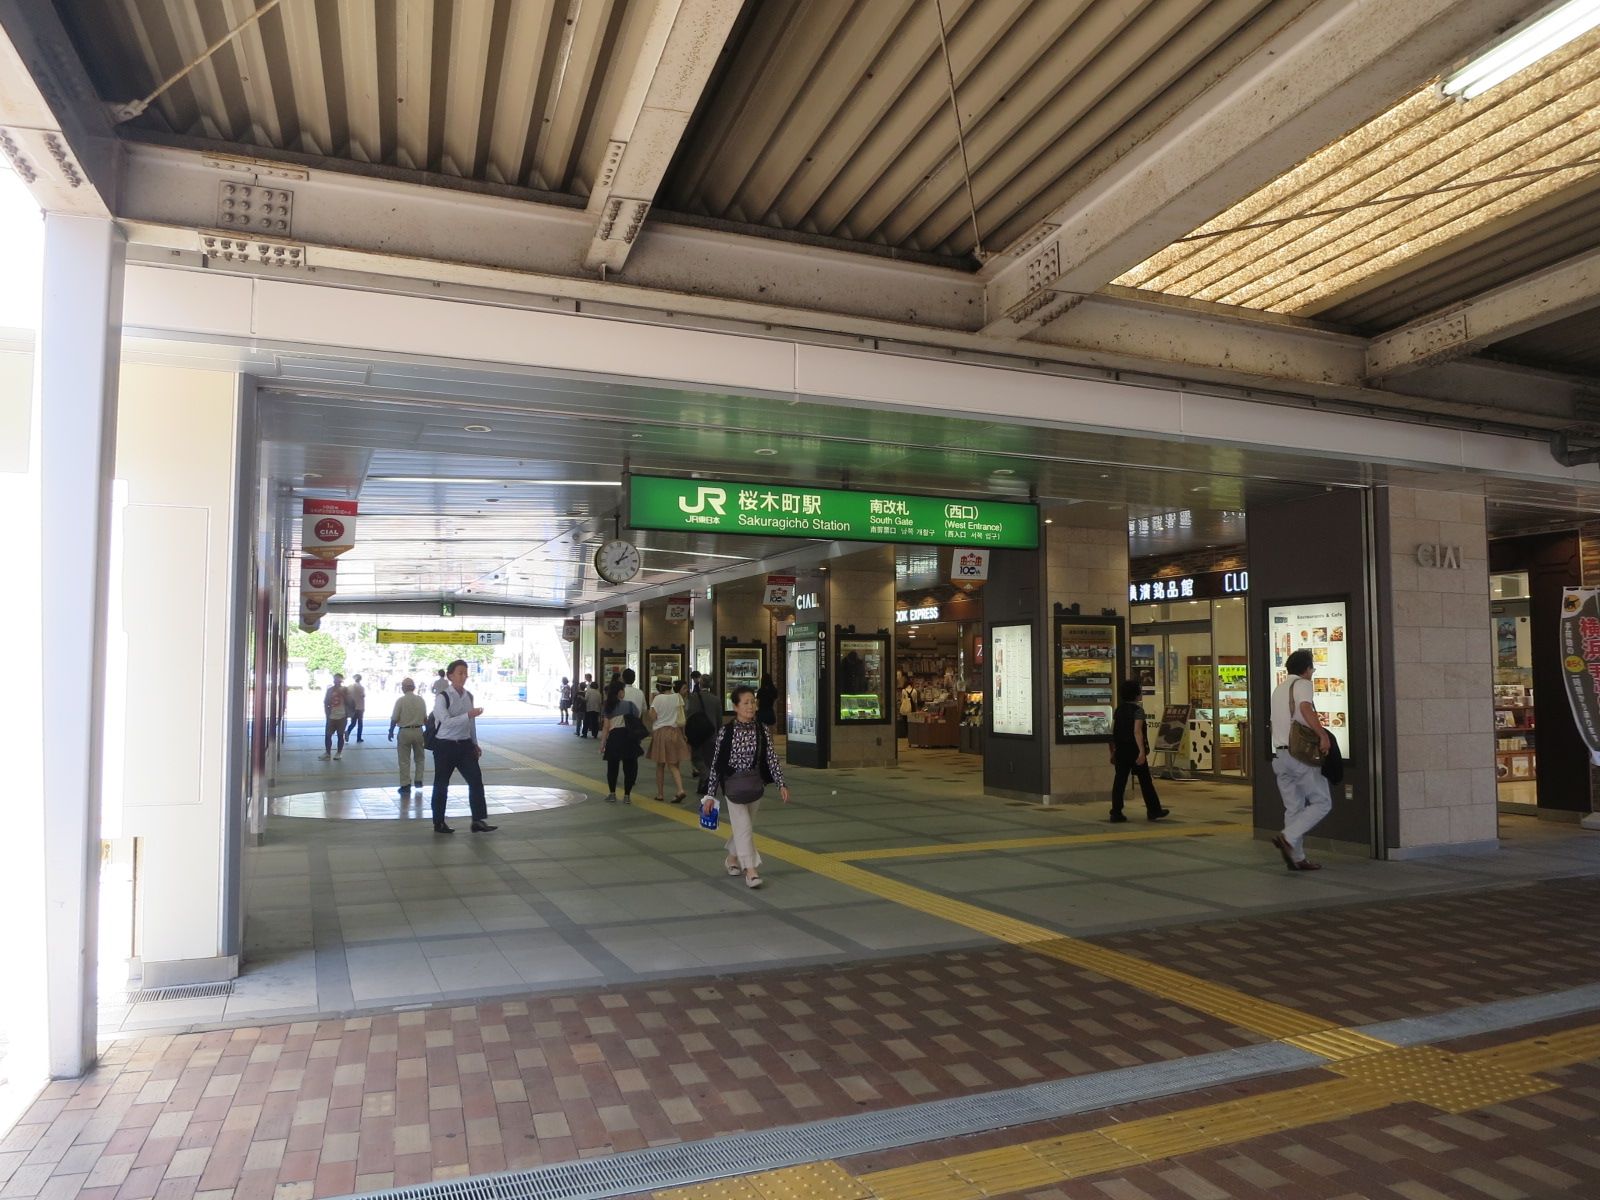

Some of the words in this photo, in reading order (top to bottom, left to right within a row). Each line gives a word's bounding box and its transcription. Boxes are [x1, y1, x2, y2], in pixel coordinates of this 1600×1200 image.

[679, 487, 727, 515] JR
[738, 490, 821, 515] 桜木町駅
[870, 499, 909, 515] 南改札
[685, 515, 720, 524] JR東日本
[944, 504, 979, 520] (西口)
[738, 514, 808, 530] Sakuragichō
[812, 518, 850, 531] Station
[870, 515, 892, 525] South
[895, 516, 913, 526] Gate
[945, 520, 966, 530] (West
[968, 522, 1003, 532] Entrance)
[1417, 543, 1465, 568] CIAL
[796, 592, 819, 609] CIAL
[910, 607, 938, 620] EXPRESS
